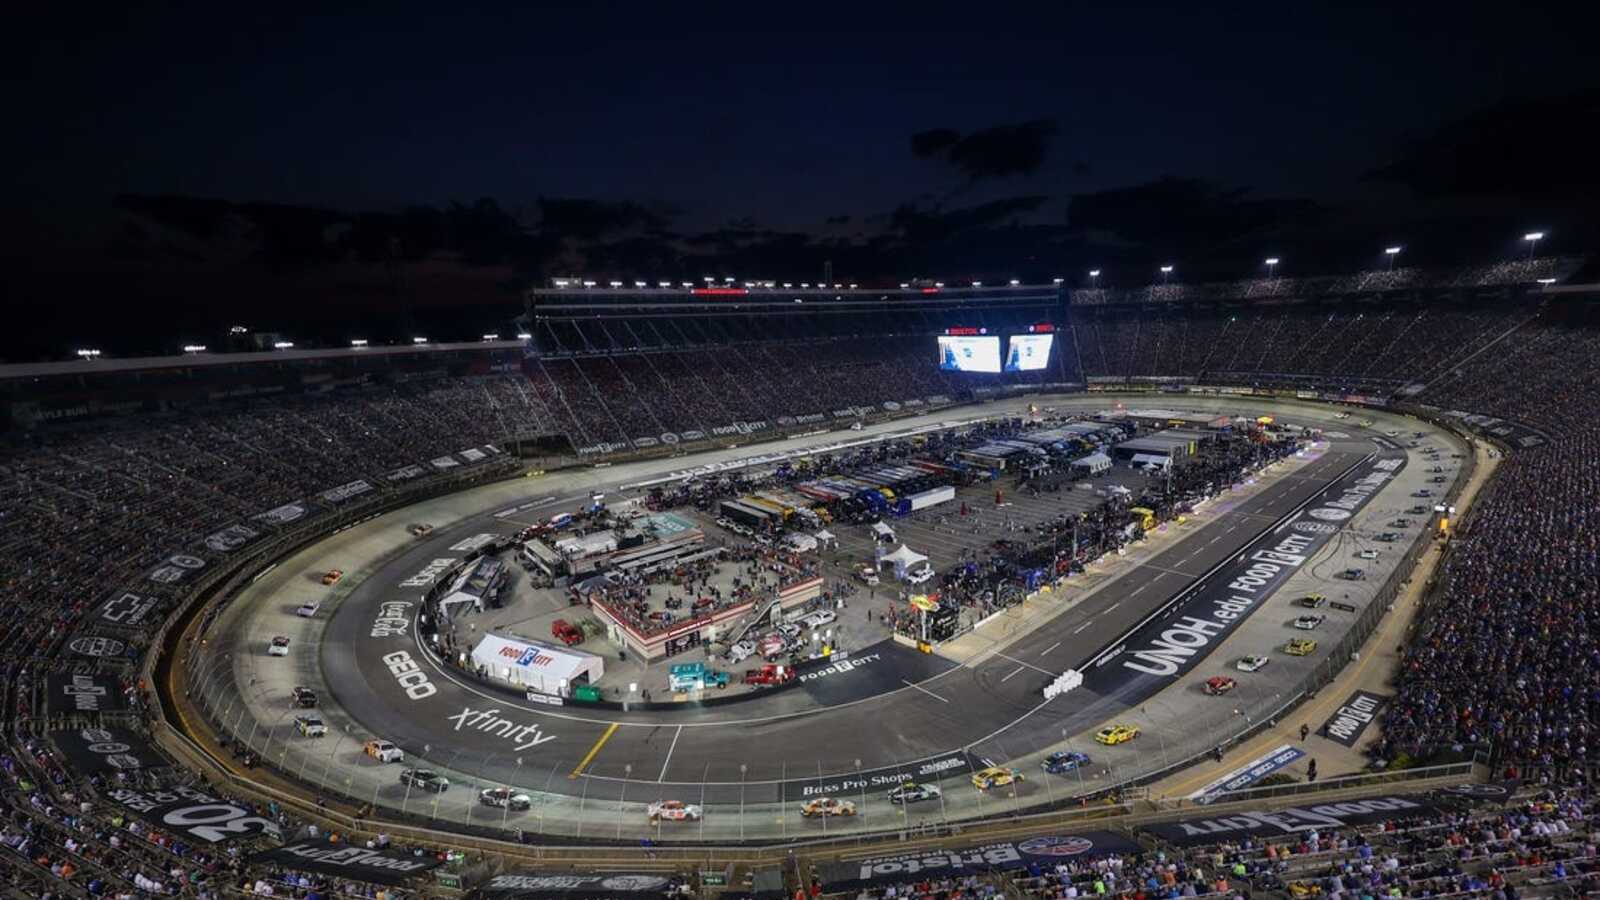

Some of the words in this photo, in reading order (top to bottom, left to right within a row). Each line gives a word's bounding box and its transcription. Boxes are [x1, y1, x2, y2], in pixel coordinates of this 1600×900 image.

[1228, 562, 1281, 593] FOOD
[1278, 533, 1315, 557] CITY
[498, 646, 522, 659] FOOD
[532, 654, 554, 667] CITY
[799, 667, 836, 683] FOOD
[853, 653, 882, 667] CITY
[382, 650, 437, 700] GEICO
[448, 707, 557, 751] xfinity
[1328, 716, 1360, 739] FOOD
[802, 783, 840, 796] Bass
[843, 778, 868, 790] Pro
[871, 772, 914, 786] Shops
[1309, 797, 1422, 816] FOOD
[363, 851, 424, 871] FOOD
[860, 845, 1020, 879] Bristol
